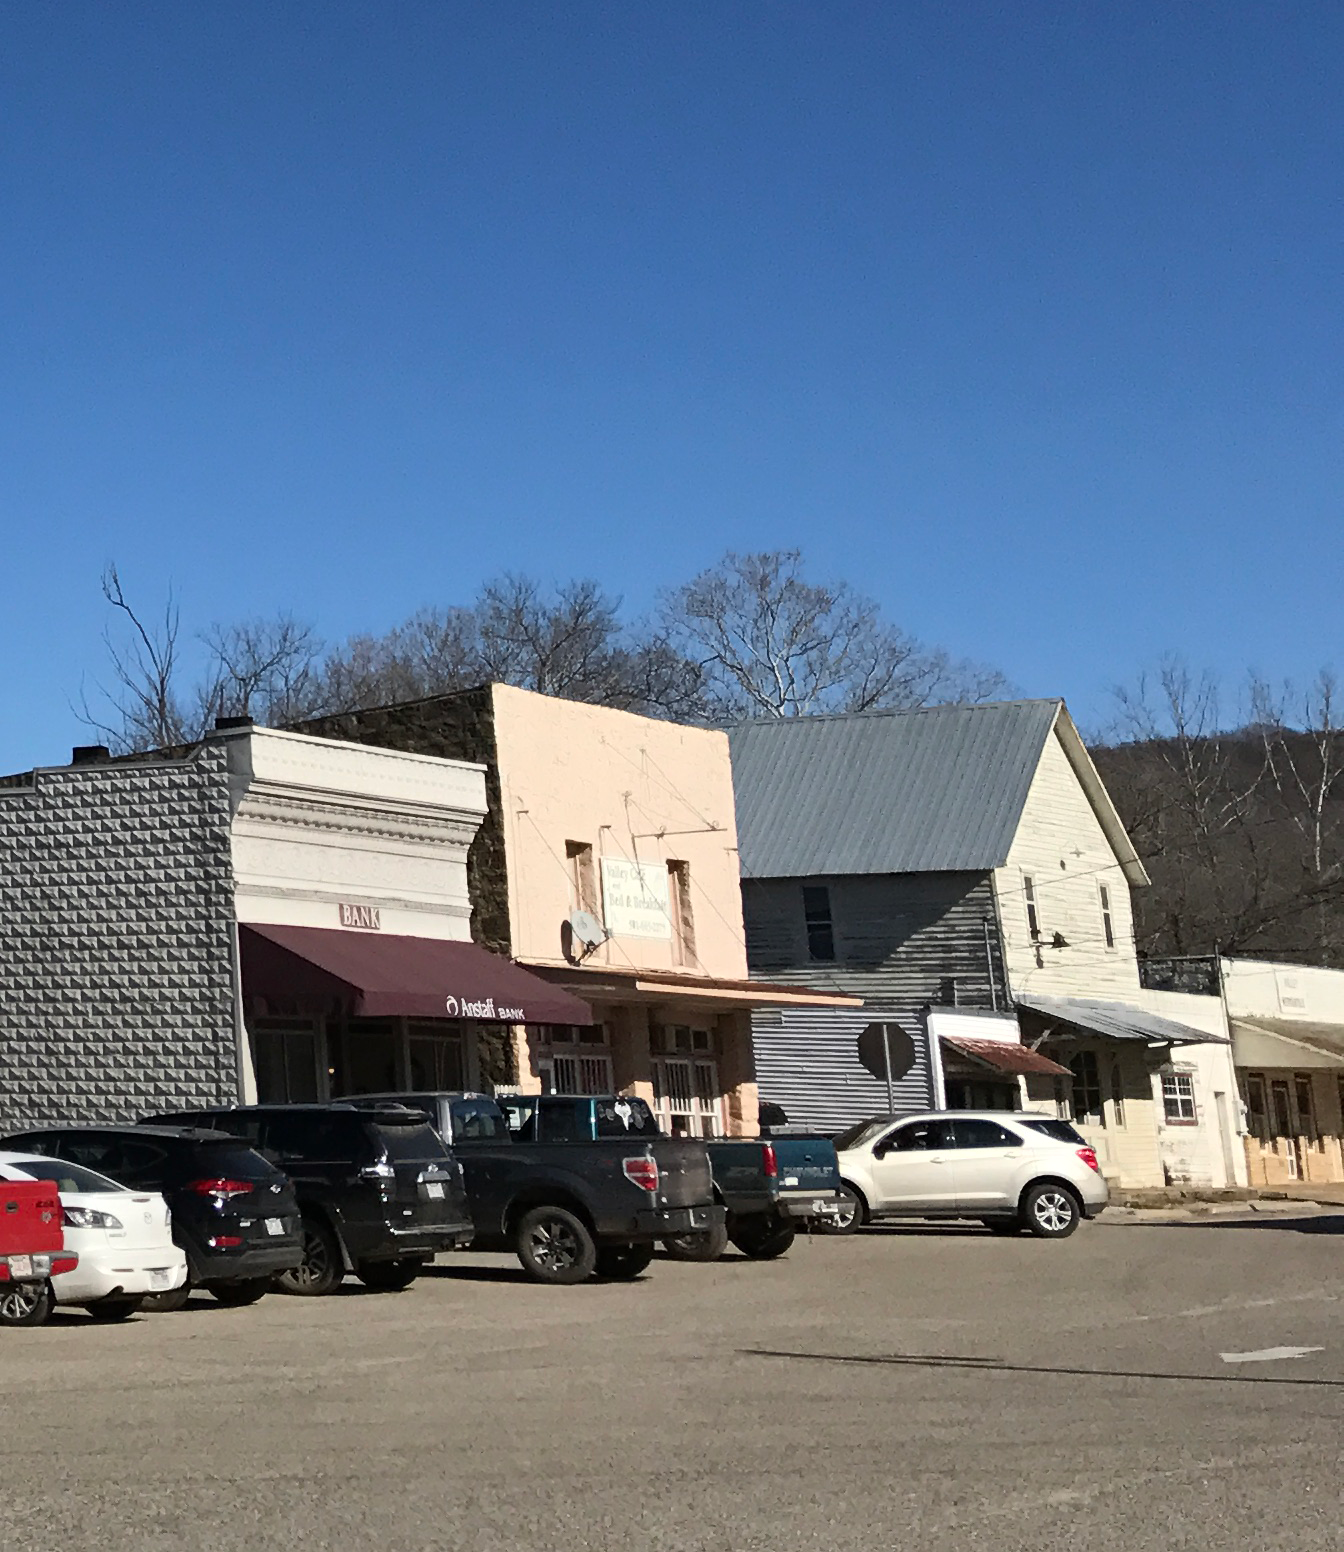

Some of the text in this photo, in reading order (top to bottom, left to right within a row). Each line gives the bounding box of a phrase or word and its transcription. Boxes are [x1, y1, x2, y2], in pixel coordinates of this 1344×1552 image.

[343, 905, 380, 928] BANK
[461, 998, 526, 1020] Anstaff BANK
